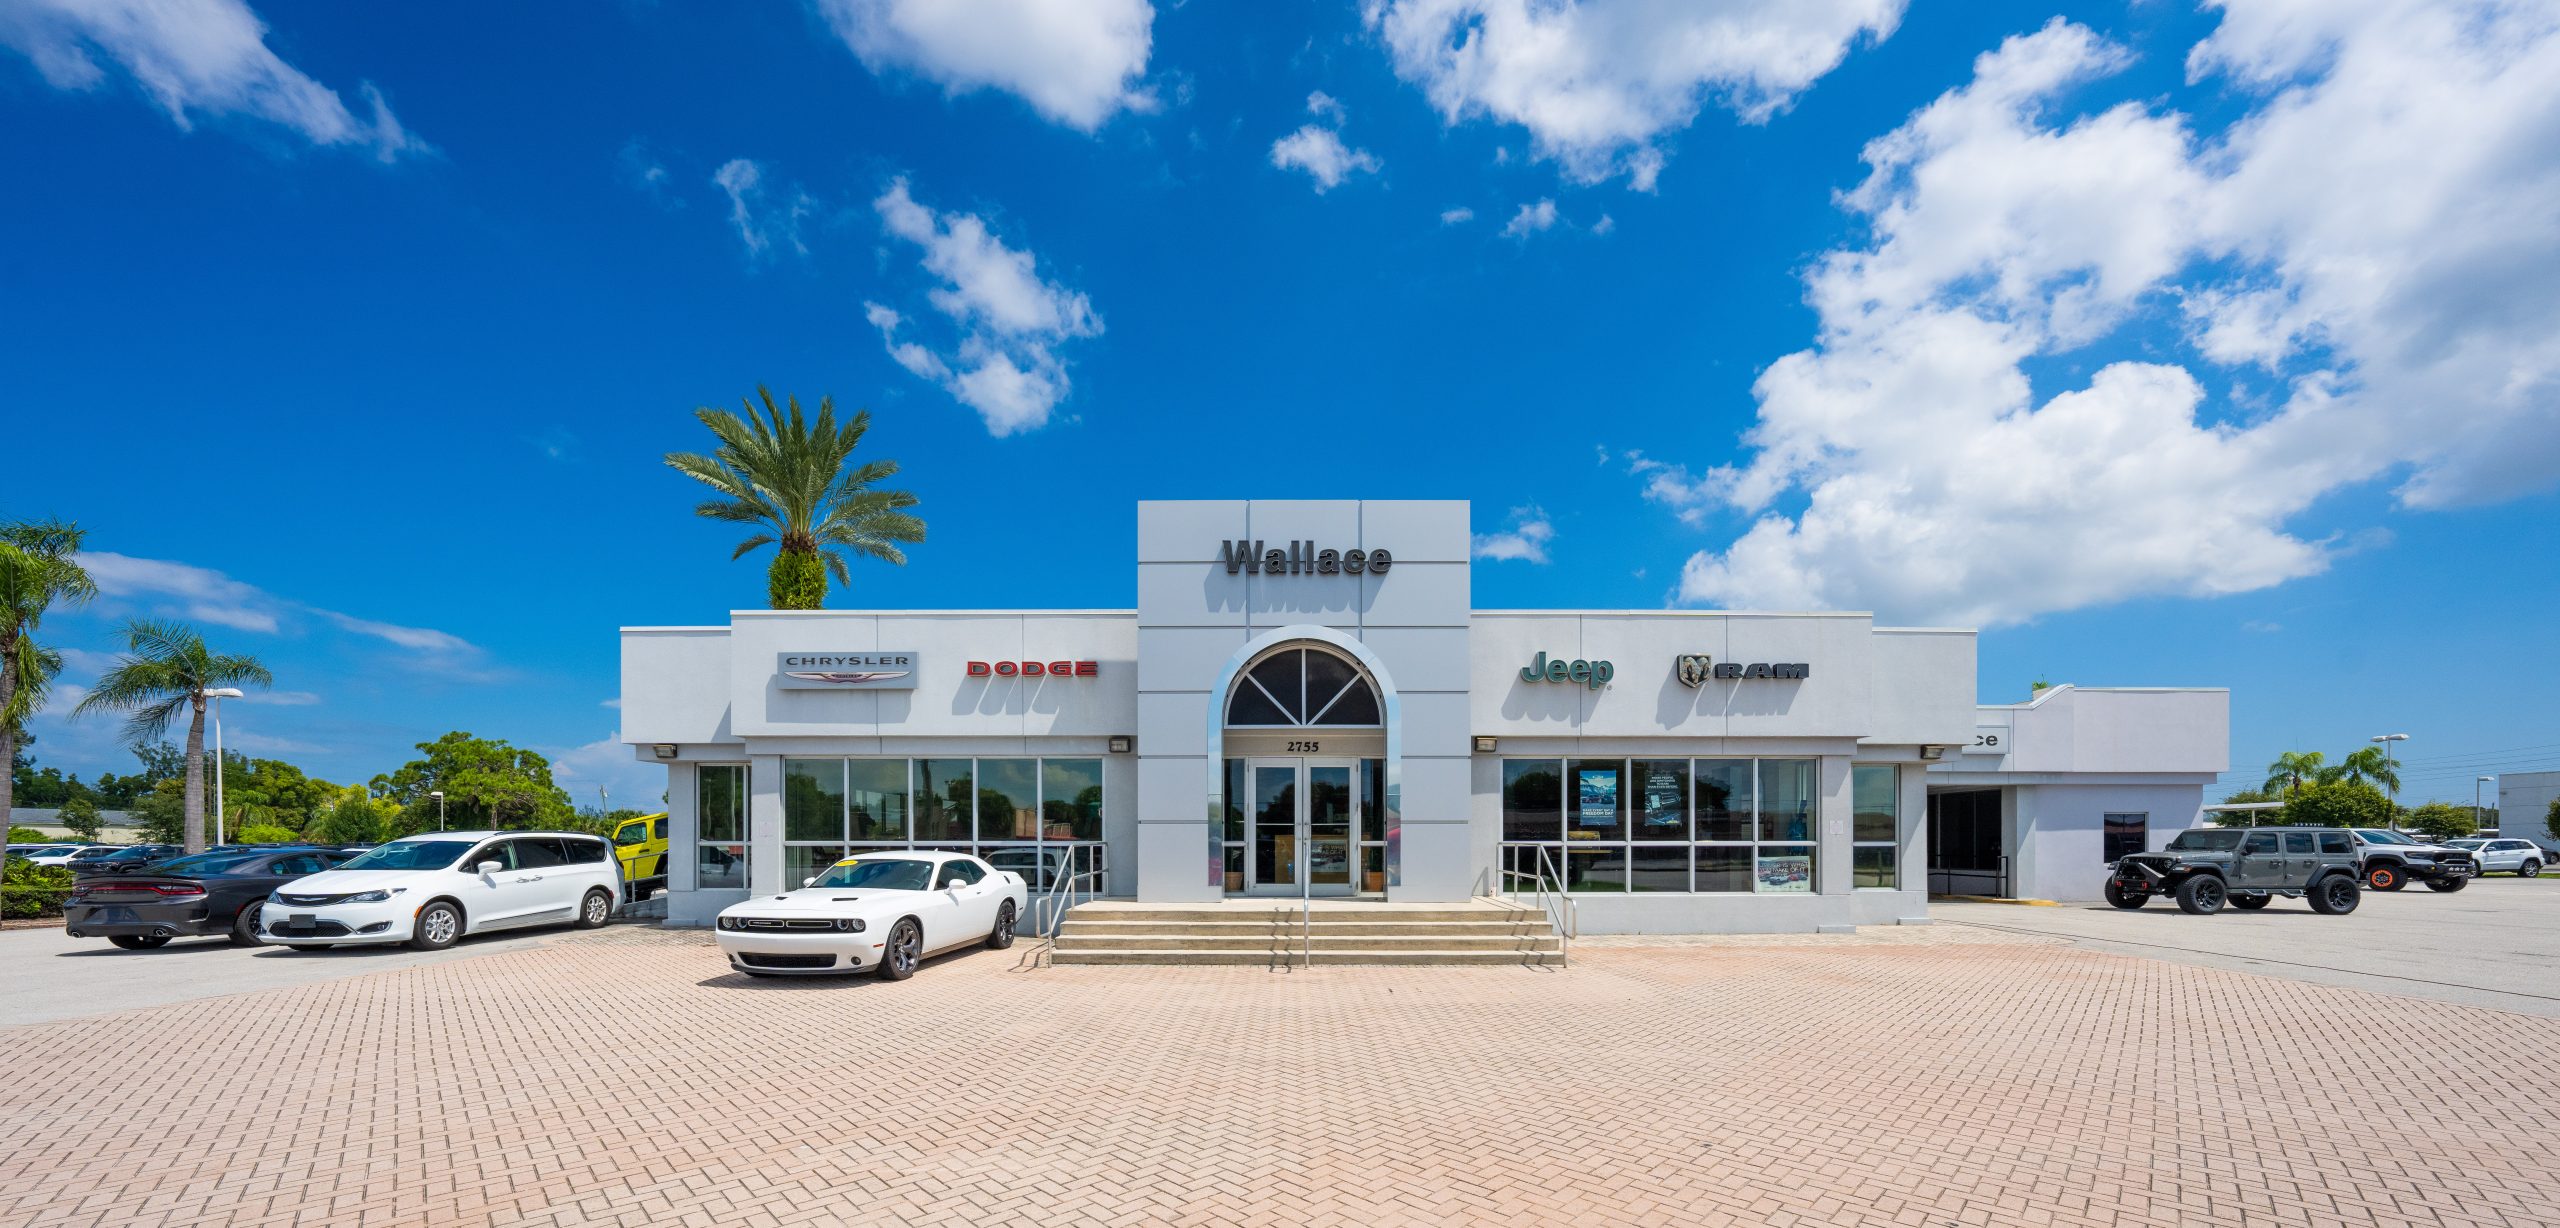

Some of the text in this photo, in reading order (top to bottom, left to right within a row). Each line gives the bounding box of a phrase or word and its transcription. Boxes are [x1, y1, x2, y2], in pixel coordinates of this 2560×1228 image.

[1222, 540, 1392, 574] Wallace
[785, 656, 909, 666] CHRYSLER
[966, 660, 1098, 677] DODGE
[1520, 651, 1614, 690] Jeep
[1714, 662, 1810, 679] RAM
[1287, 741, 1319, 752] 2755
